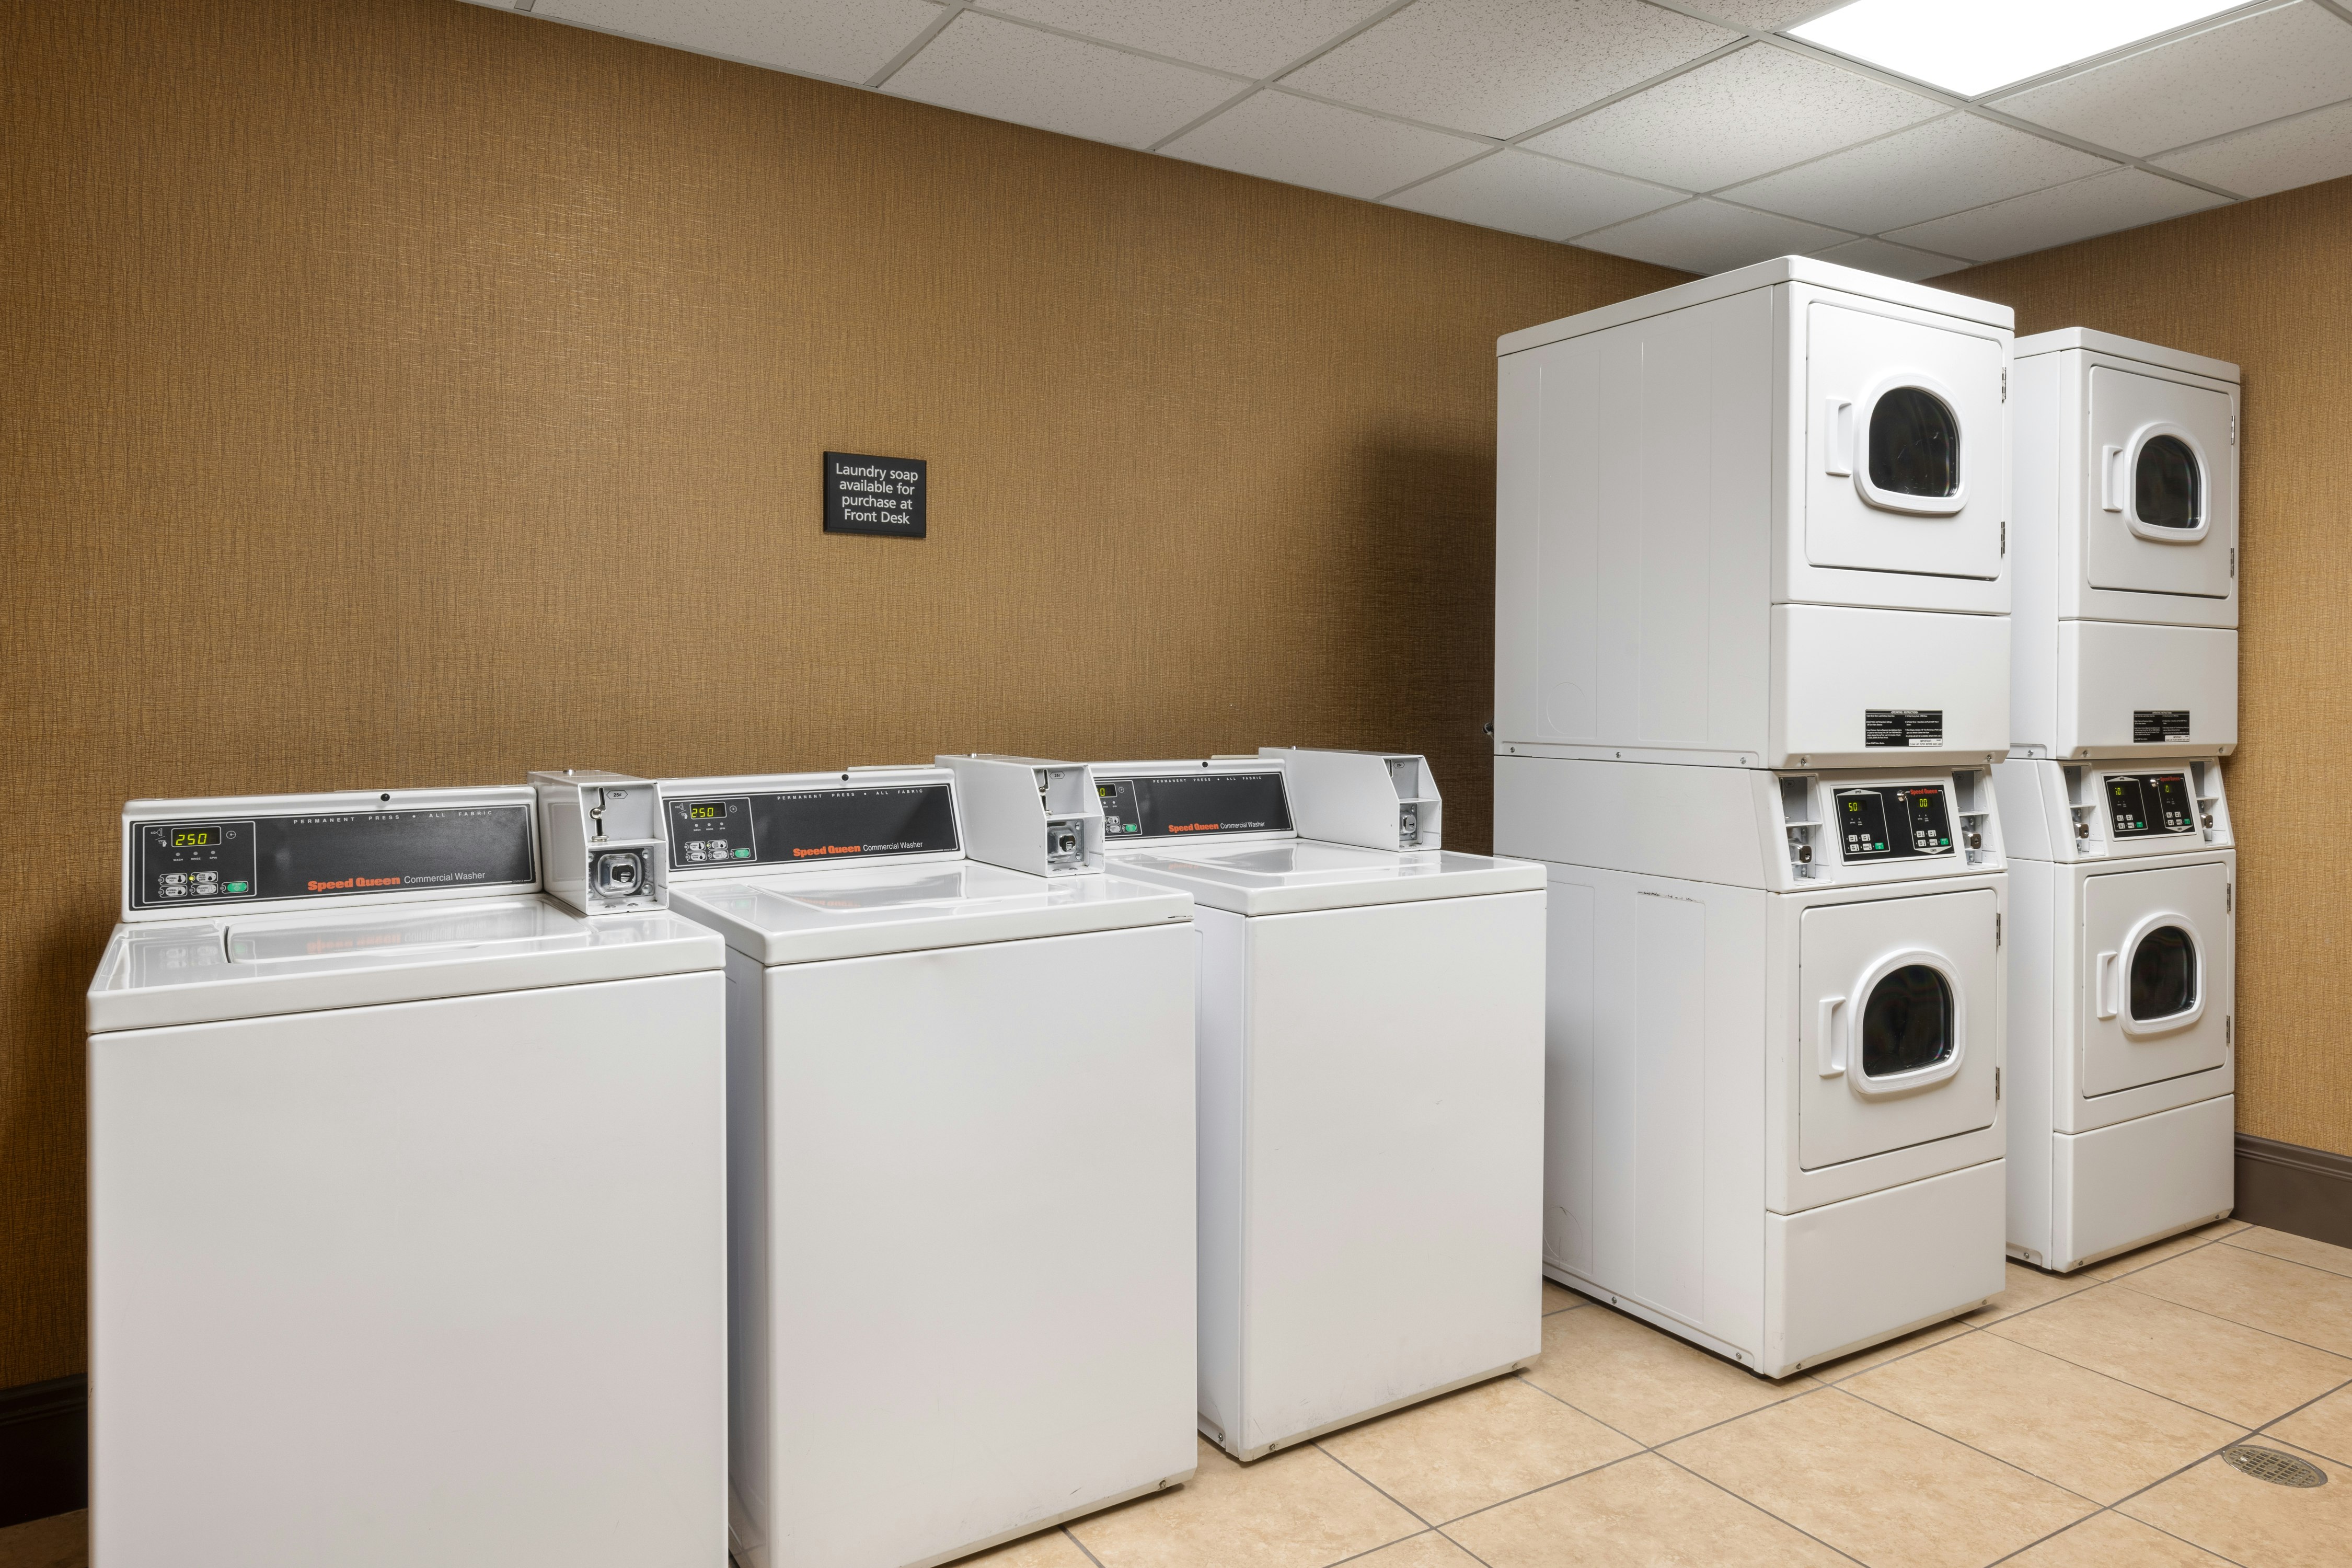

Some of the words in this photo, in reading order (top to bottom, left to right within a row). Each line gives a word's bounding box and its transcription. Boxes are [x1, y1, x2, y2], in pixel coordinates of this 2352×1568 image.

[836, 463, 886, 480] Laundry
[890, 470, 918, 483] soap
[839, 480, 893, 493] available
[897, 482, 915, 495] for
[842, 495, 896, 508] purchase
[900, 499, 913, 510] at
[845, 509, 877, 522] Front
[881, 511, 910, 524] Desk
[1848, 803, 1857, 811] 50
[1919, 798, 1927, 807] 00
[691, 808, 713, 818] 250
[1168, 824, 1194, 833] Speed
[176, 833, 207, 845] 250
[793, 846, 827, 857] Speed
[828, 845, 861, 854] Queen
[863, 843, 899, 851] Commercial
[307, 878, 353, 892] Speed
[355, 877, 401, 887] Queen
[404, 873, 453, 884] Commercial
[454, 872, 485, 880] Washer
